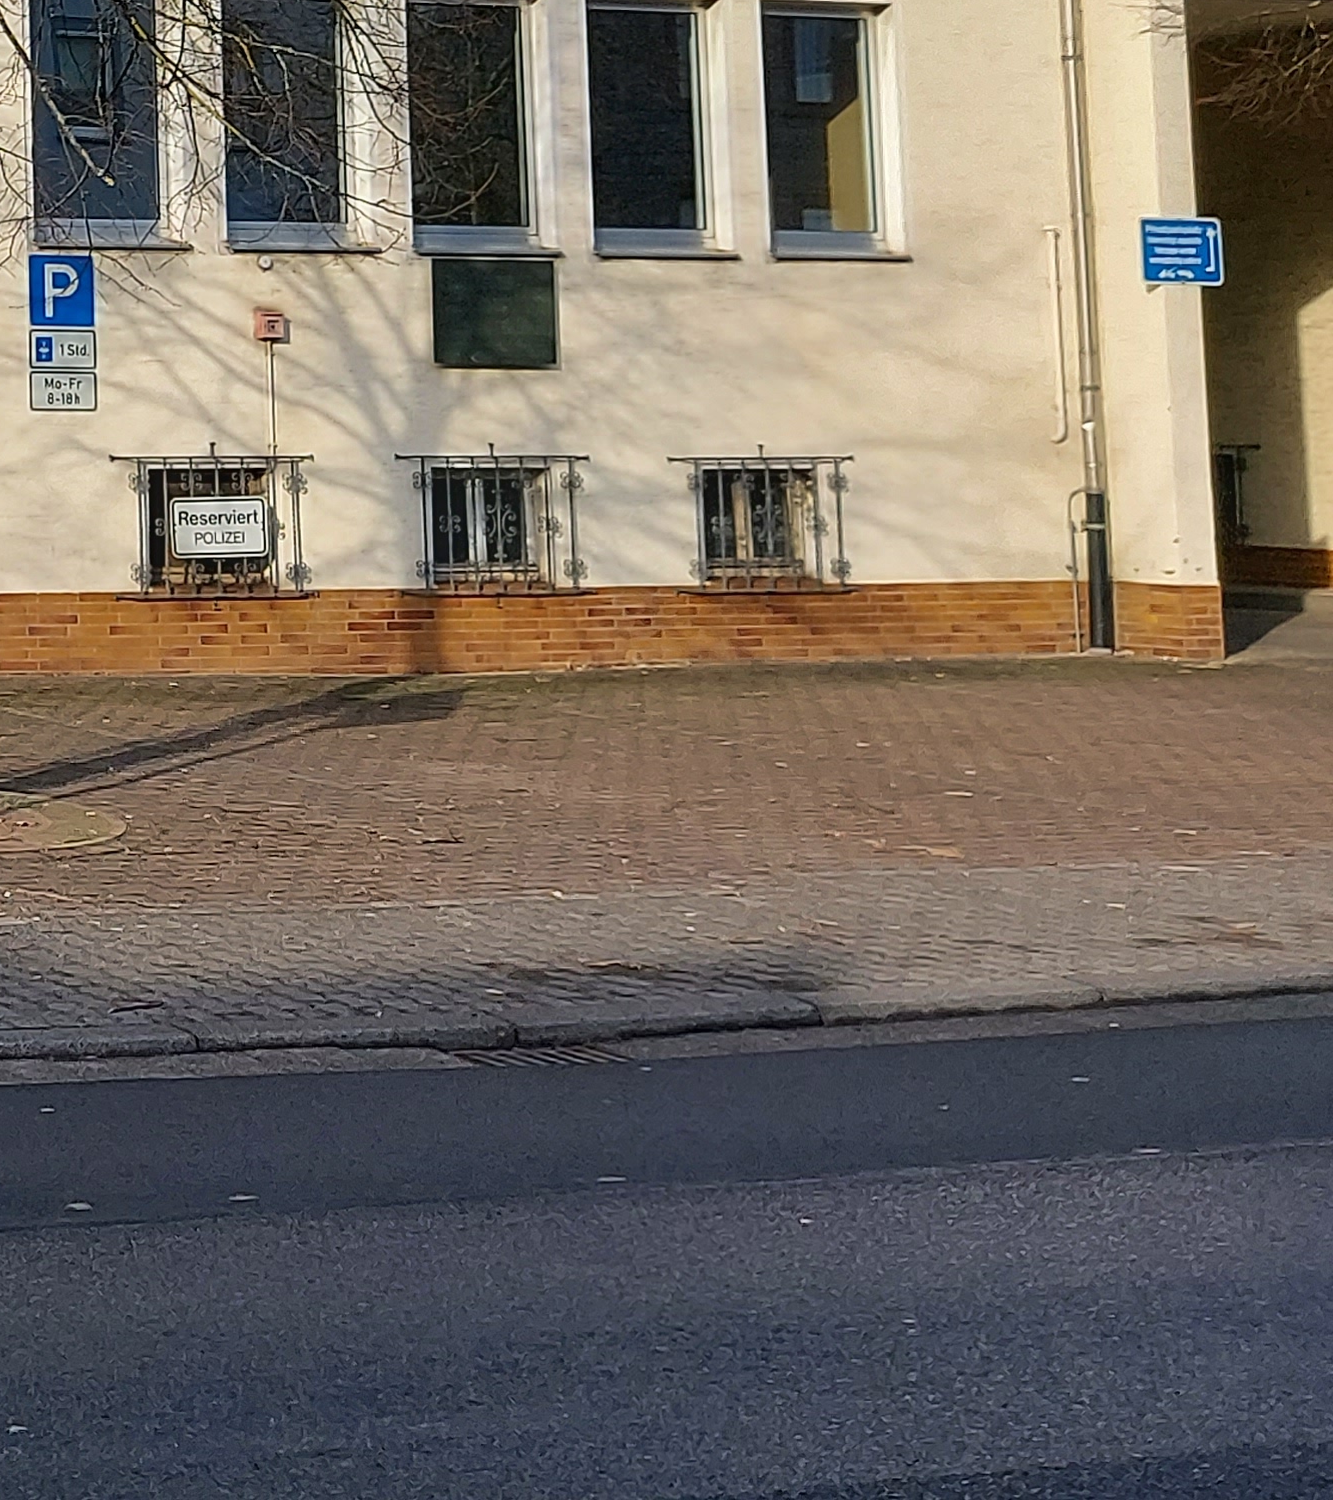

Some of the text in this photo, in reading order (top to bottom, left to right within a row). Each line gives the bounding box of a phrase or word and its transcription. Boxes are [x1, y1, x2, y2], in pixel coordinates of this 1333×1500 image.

[44, 263, 80, 318] P
[59, 343, 90, 357] 1 Std.
[44, 377, 83, 390] Mo-Fr
[178, 509, 259, 526] Reserviert
[194, 531, 246, 547] POLIZEI
